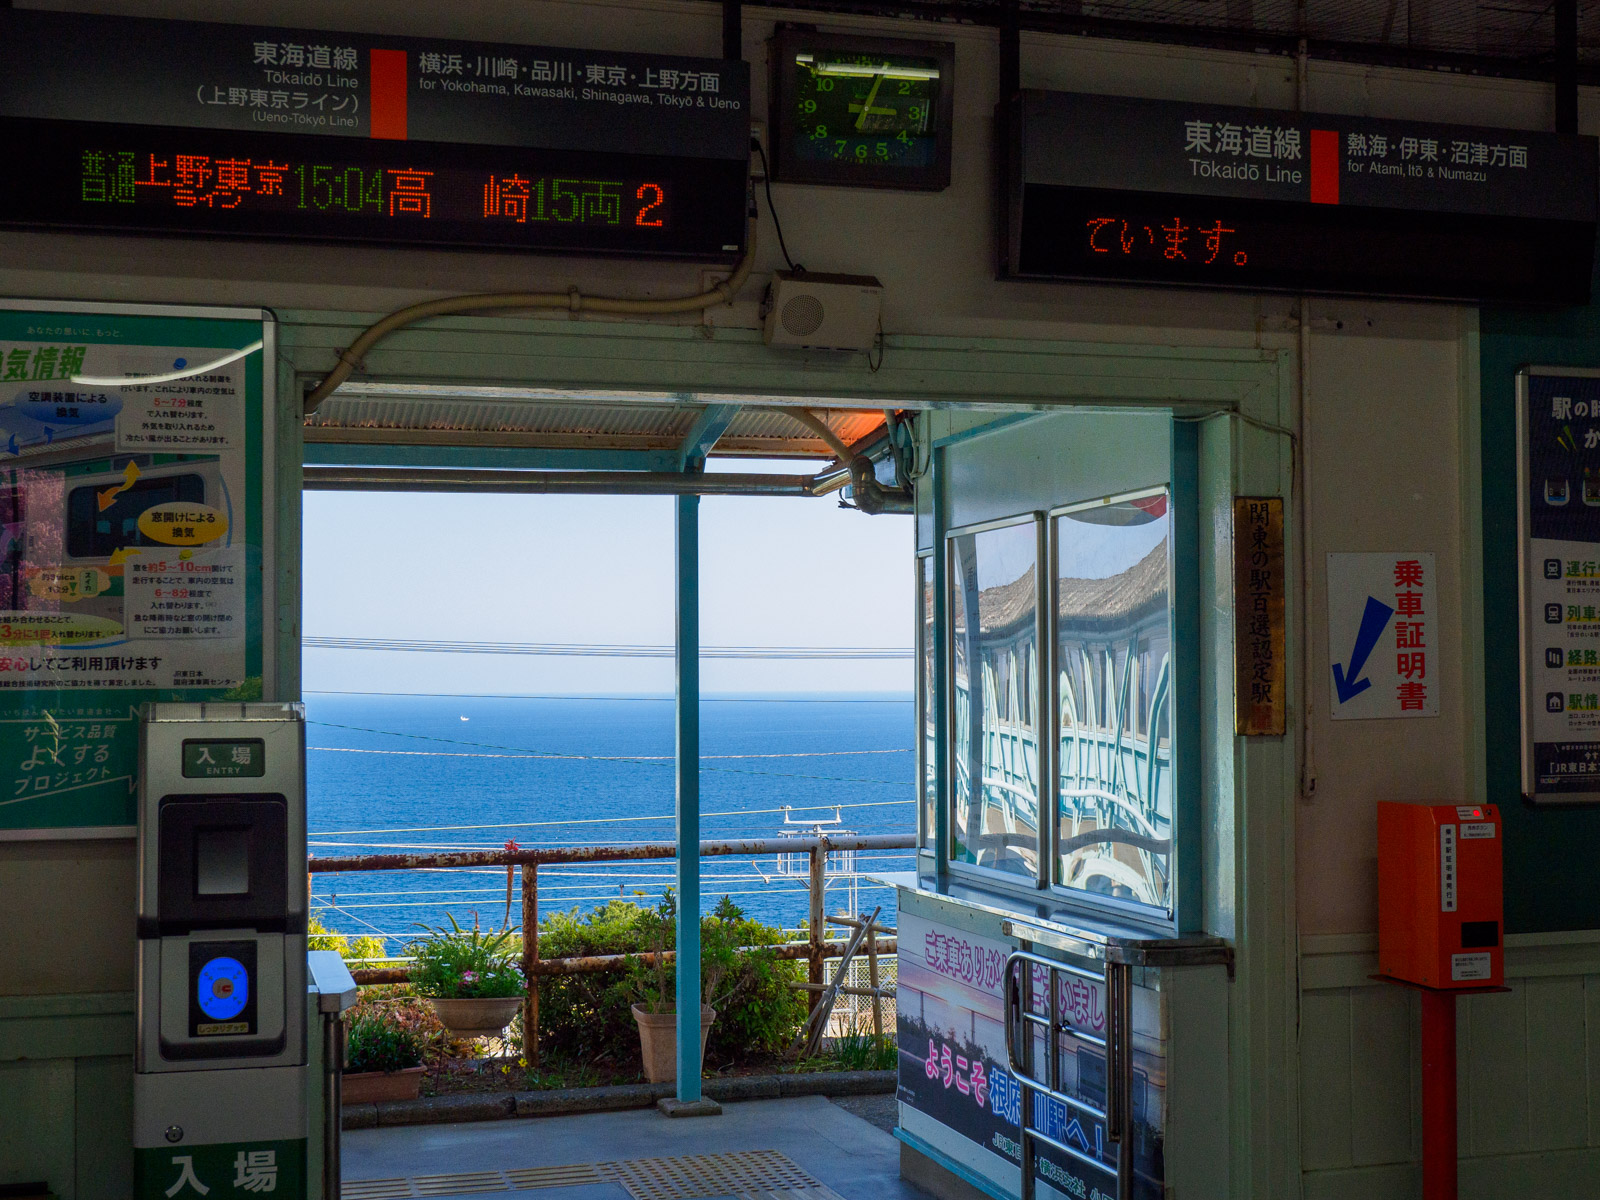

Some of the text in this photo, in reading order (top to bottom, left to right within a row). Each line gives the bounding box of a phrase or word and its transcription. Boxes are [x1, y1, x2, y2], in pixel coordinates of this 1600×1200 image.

[253, 41, 359, 71] 東海道線
[264, 69, 359, 88] Tōkaidō Line
[419, 52, 720, 93] 横浜・川崎・品川・東京・上野方面
[816, 78, 834, 92] 10
[899, 82, 910, 95] 2
[197, 85, 359, 113] （上野東京ライン）
[419, 77, 741, 110] for Yokohama, Kawasaki, Shinagawa, Tōkyō & Ueno
[804, 100, 817, 114] 9
[908, 107, 920, 120] 3
[330, 114, 359, 128] Line)
[815, 125, 828, 139] 8
[897, 130, 908, 143] 4
[835, 140, 847, 153] 7
[1184, 120, 1302, 161] 東海道線
[856, 145, 867, 158] 6
[876, 143, 888, 156] 5
[1347, 133, 1528, 169] 熱海・伊東・沼津方面
[1189, 158, 1302, 184] Tōkaidō Line
[1347, 160, 1364, 173] for
[1369, 161, 1407, 178] Atami,
[1427, 167, 1435, 179] &
[1438, 167, 1487, 182] Numazu
[82, 150, 135, 203] 普通
[294, 164, 384, 212] 15:04
[531, 178, 623, 224] 15両
[636, 183, 663, 227] 2
[1086, 217, 1248, 266] ています。
[0, 346, 86, 379] 気情報
[28, 392, 107, 403] 空調装置による
[56, 407, 80, 418] 換気
[152, 512, 216, 523] 窓開けによる
[172, 527, 195, 537] 換気
[1250, 503, 1272, 703] 関東の駅百選認定駅
[1394, 560, 1427, 710] 乗車証明書
[206, 767, 241, 775] ENTRY
[1550, 761, 1600, 774] 「JR東日本
[15, 765, 111, 795] プロジェクト
